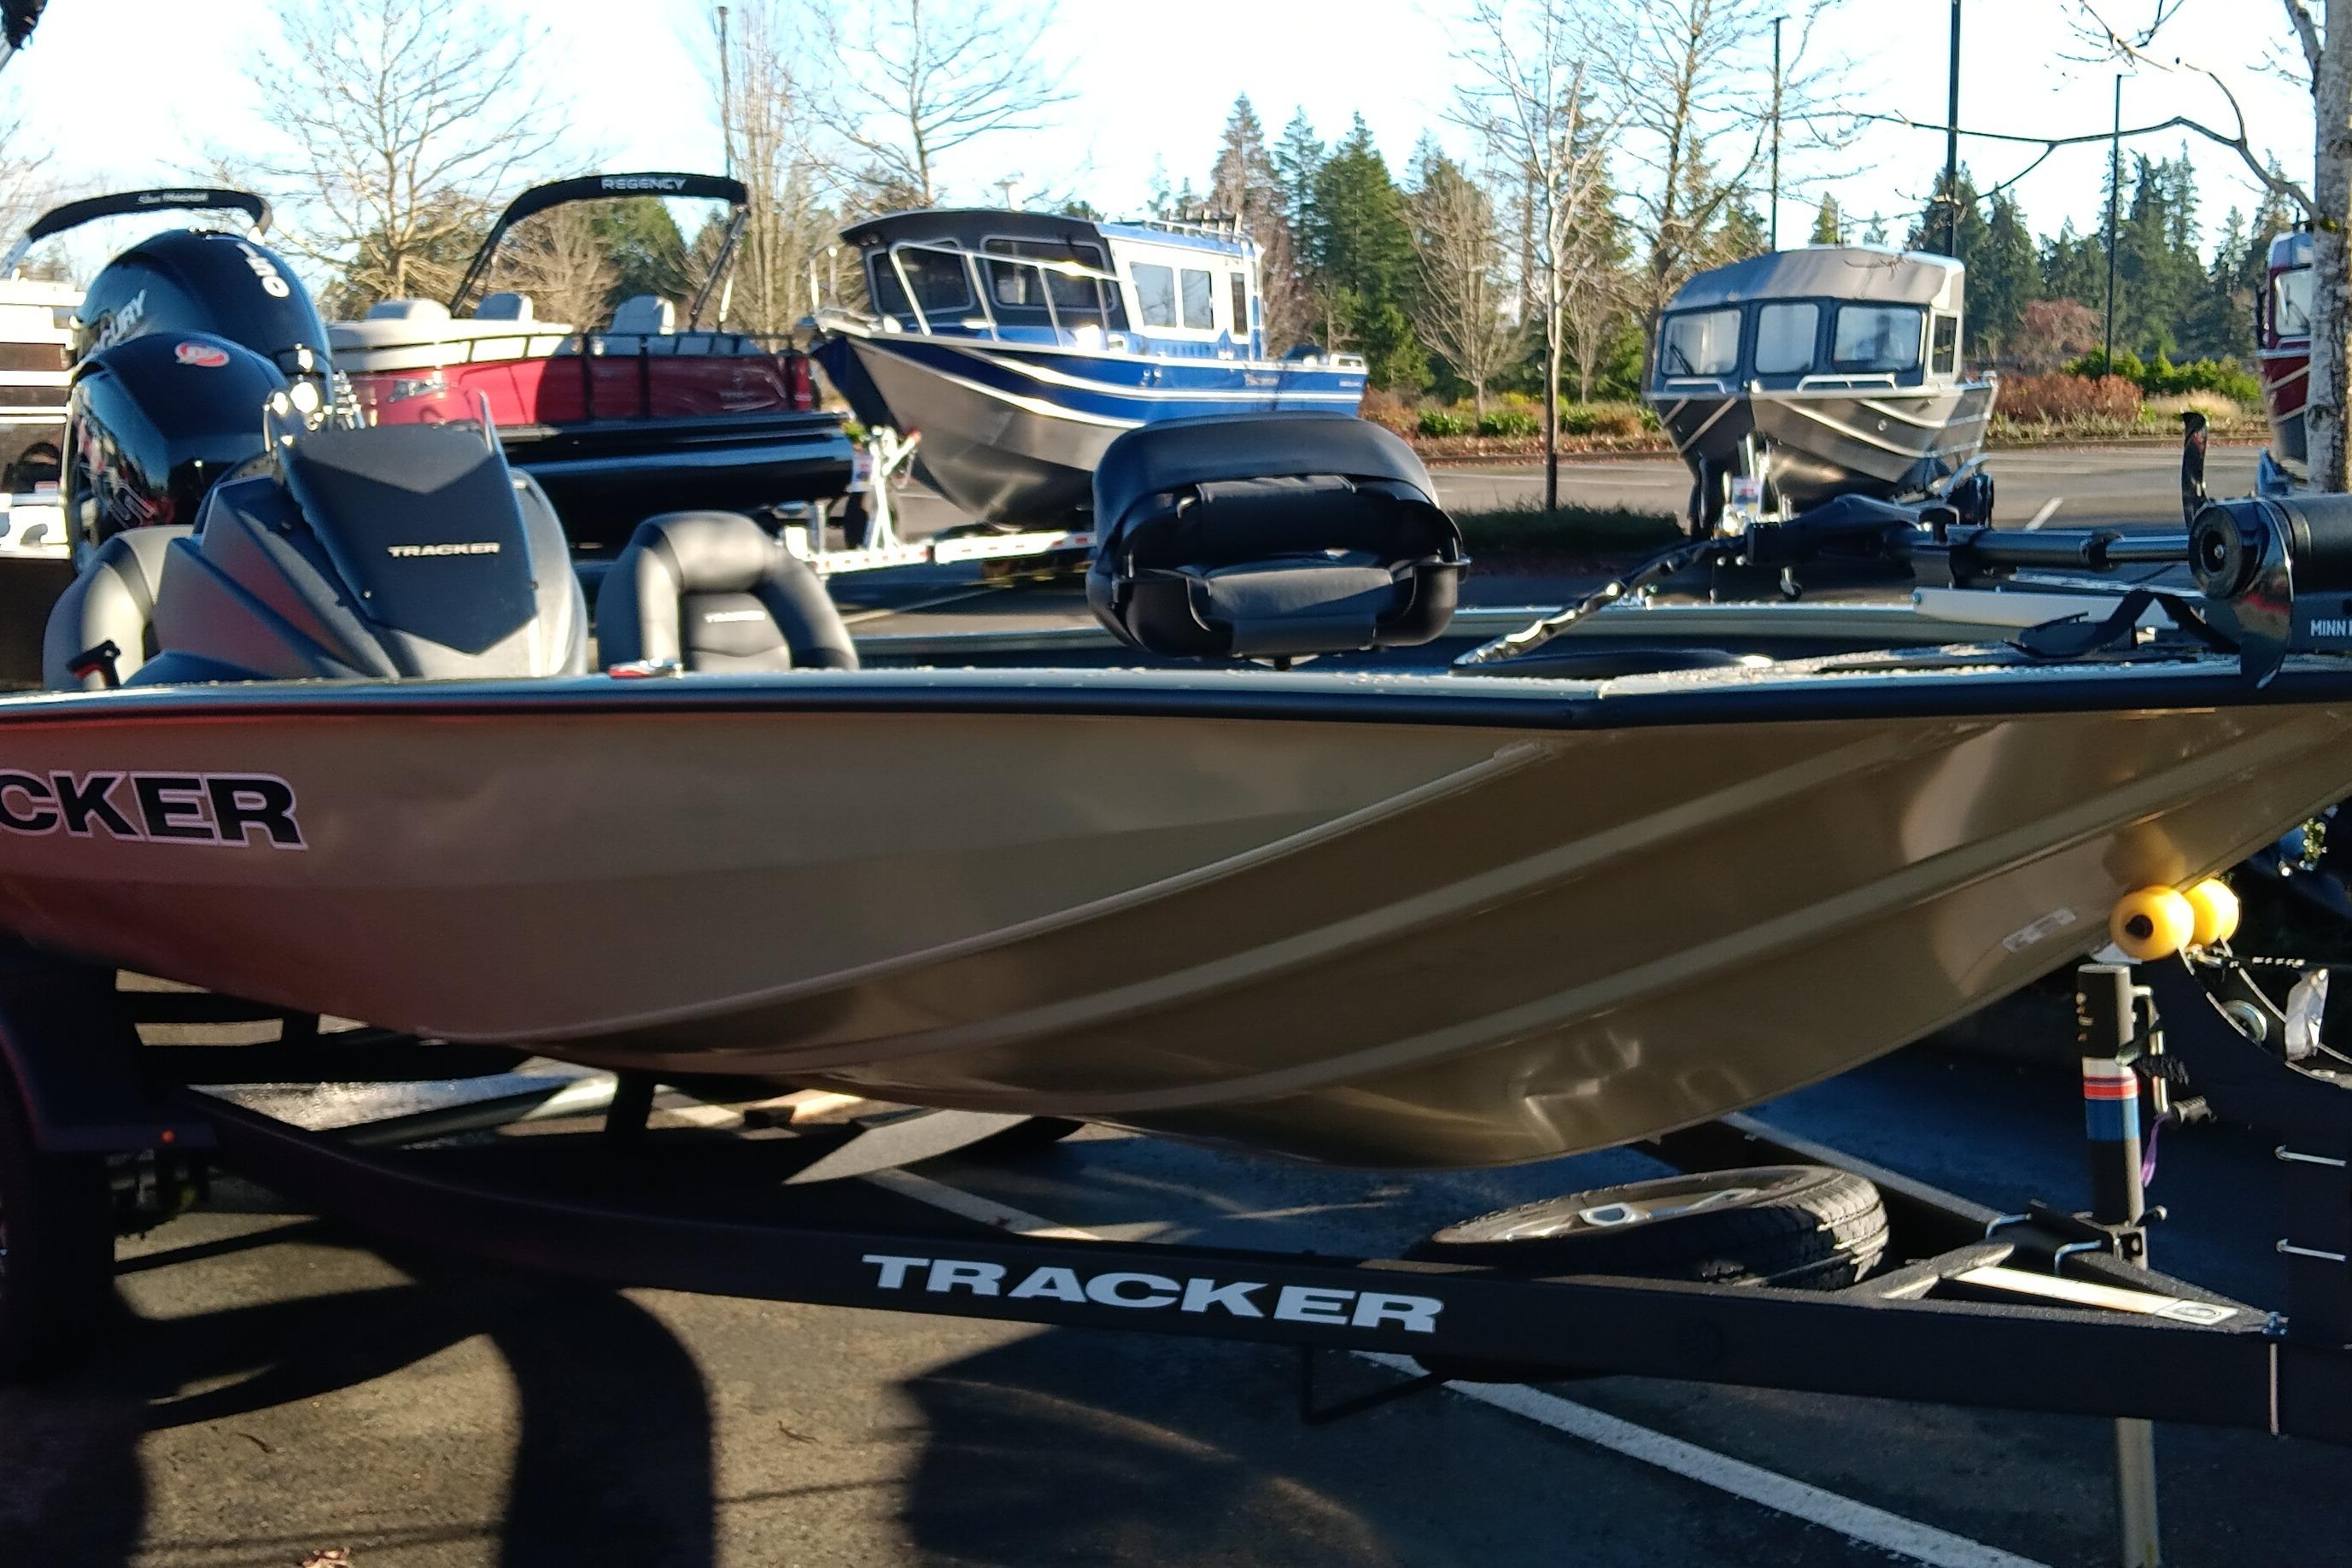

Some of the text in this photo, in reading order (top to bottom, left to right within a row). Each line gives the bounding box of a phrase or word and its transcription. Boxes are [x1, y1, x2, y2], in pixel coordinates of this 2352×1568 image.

[601, 178, 686, 190] REGENCY
[387, 542, 500, 557] TRACKER
[2310, 619, 2347, 637] MINN
[862, 1255, 1444, 1333] TRACKER
